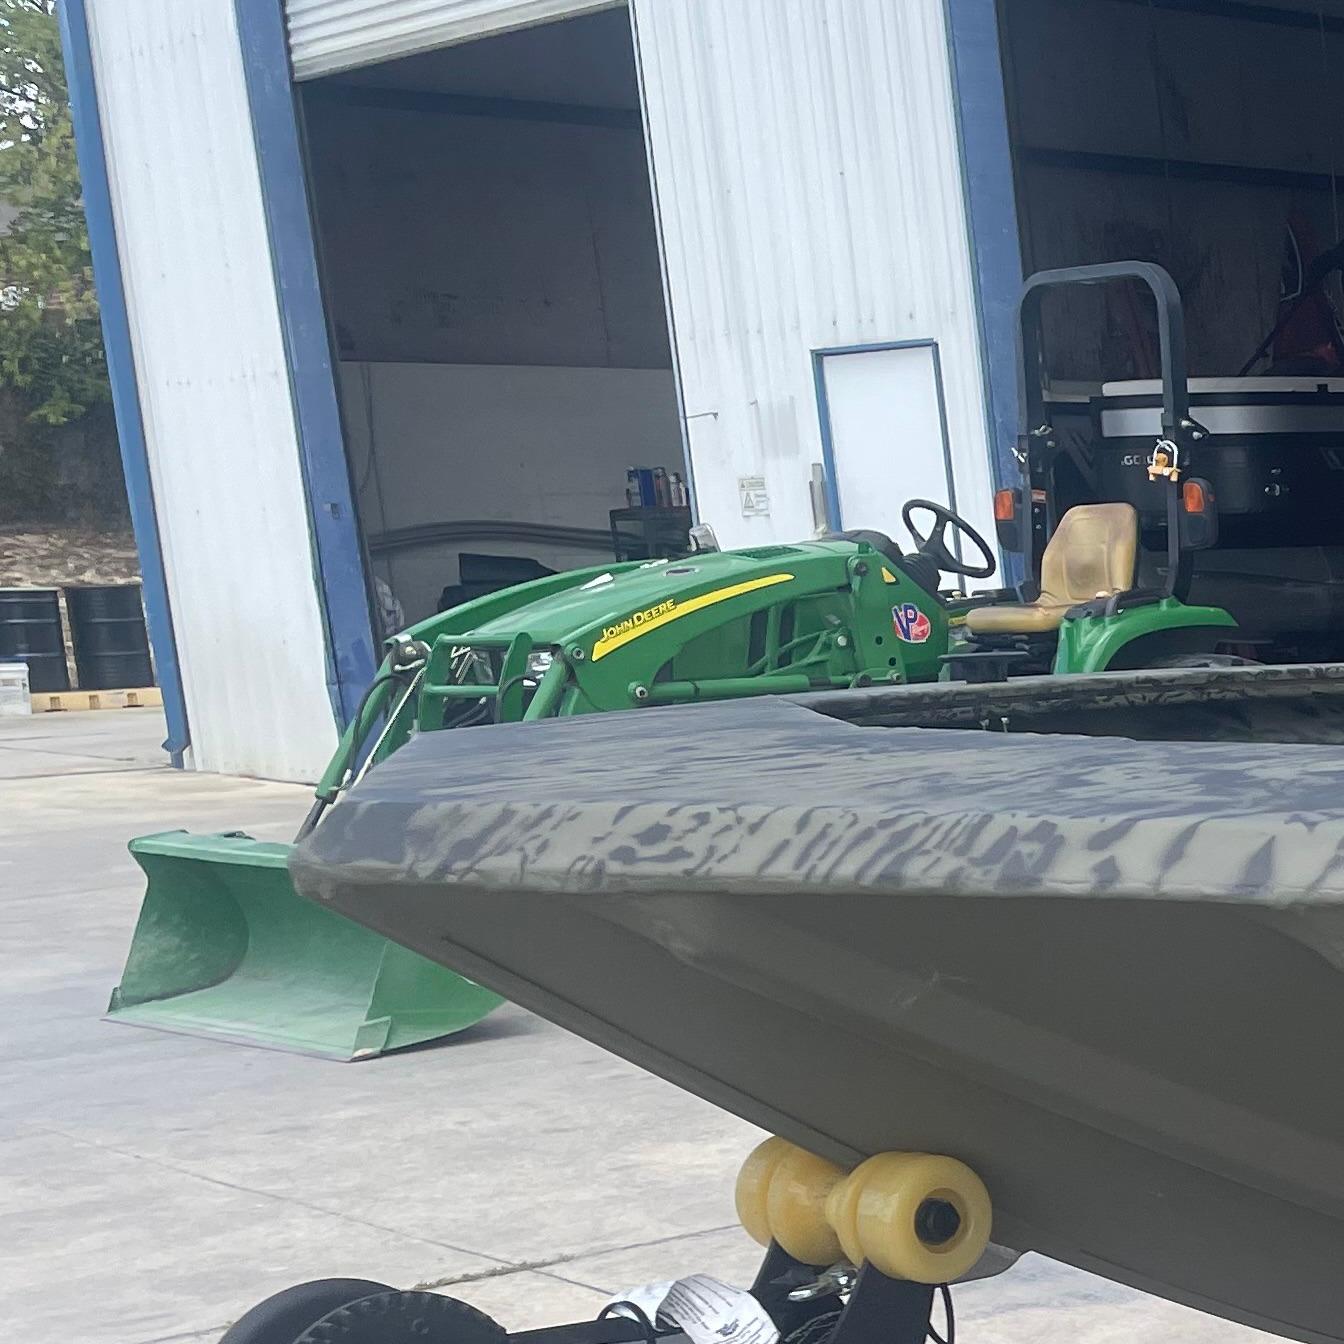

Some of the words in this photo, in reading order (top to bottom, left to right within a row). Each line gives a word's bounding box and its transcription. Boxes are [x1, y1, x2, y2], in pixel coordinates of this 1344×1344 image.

[600, 618, 633, 642] JOHN
[633, 599, 677, 627] DEERE
[892, 603, 919, 642] VP
